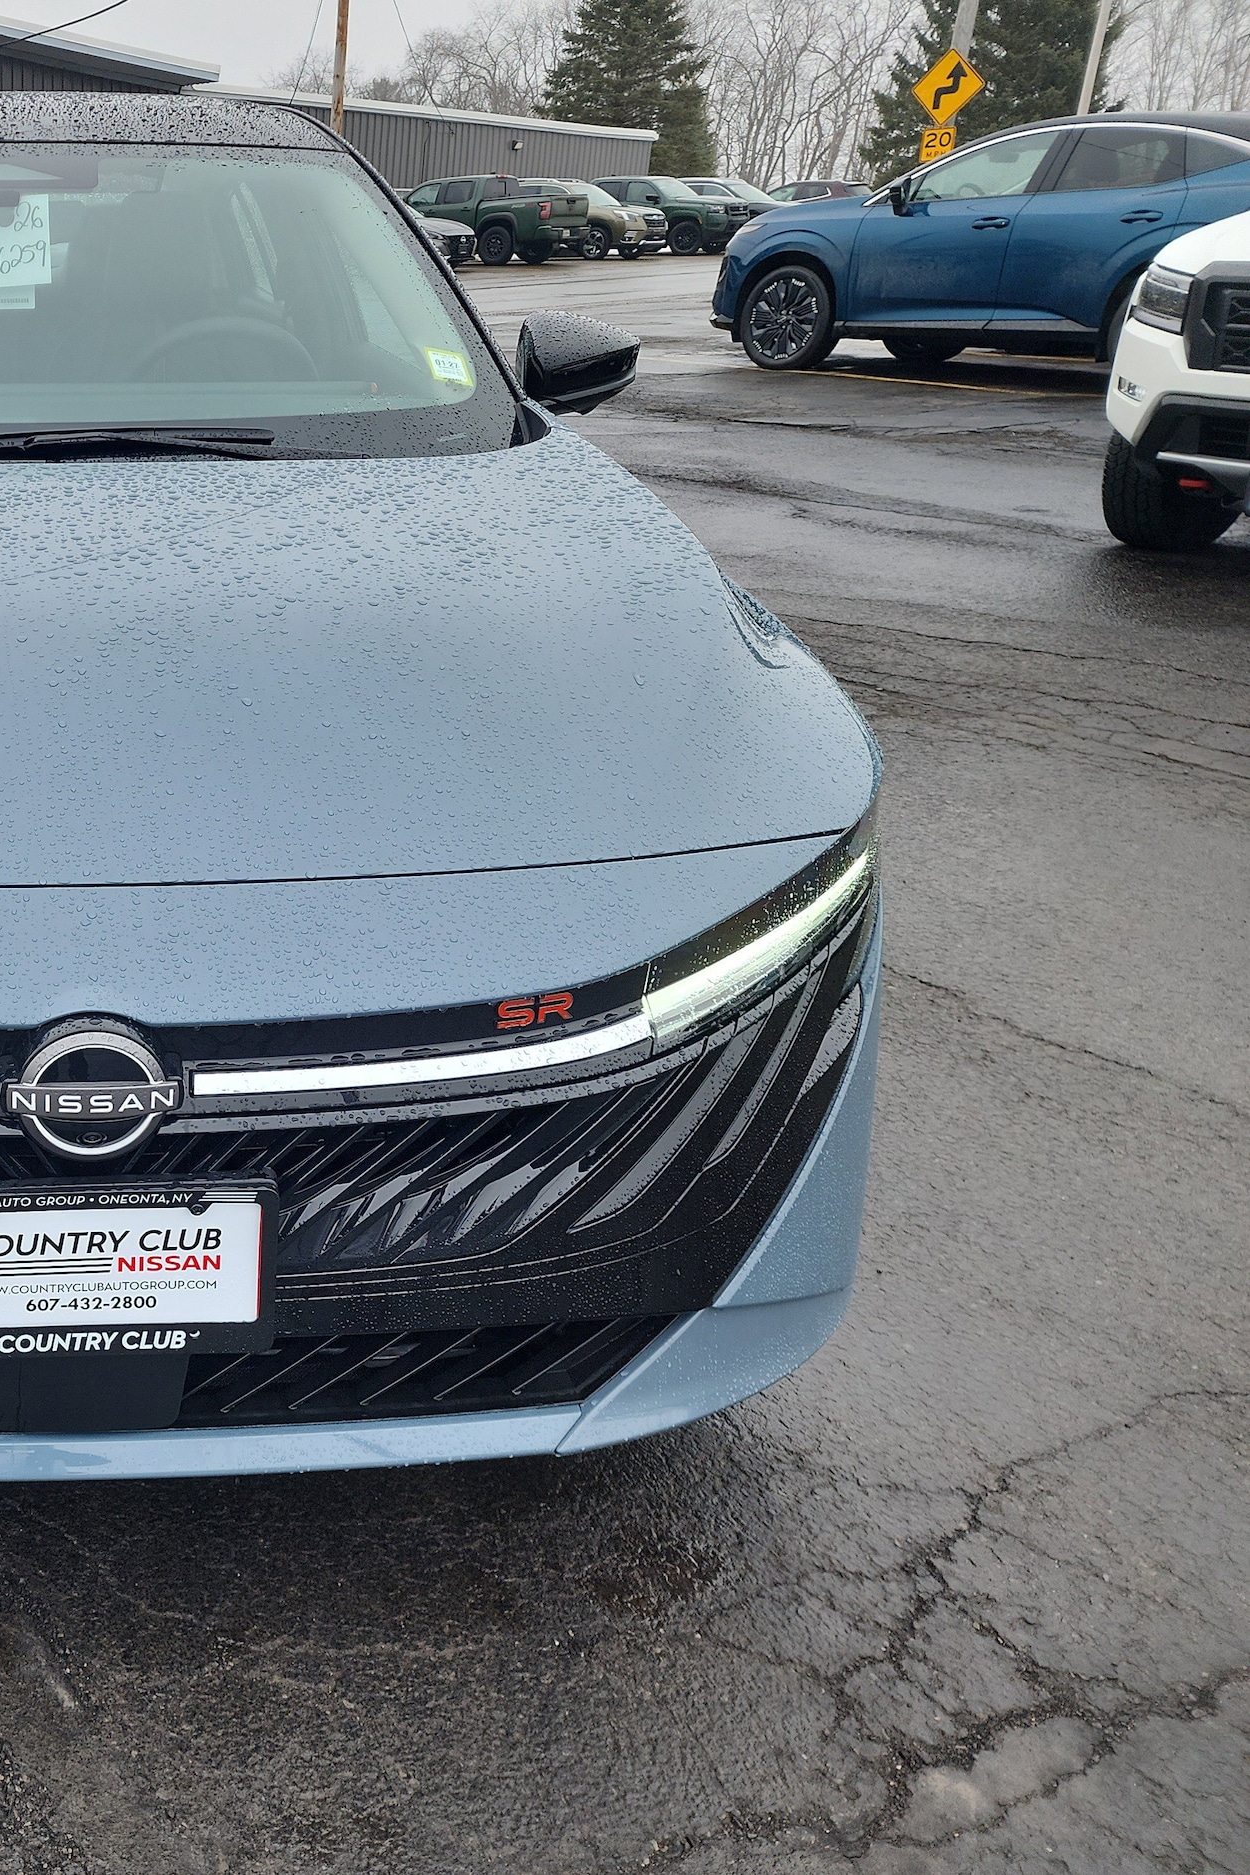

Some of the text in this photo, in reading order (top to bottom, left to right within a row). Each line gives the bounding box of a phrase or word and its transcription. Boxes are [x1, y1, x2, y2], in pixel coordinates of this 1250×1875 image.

[925, 132, 951, 148] 20
[496, 991, 574, 1030] SR
[11, 1088, 175, 1114] NISSAN
[35, 1195, 86, 1207] GROUP
[138, 1228, 223, 1252] CLUB
[117, 1254, 222, 1273] NISSAN
[25, 1295, 157, 1312] 607-432-2800
[120, 1329, 187, 1350] CLUB
